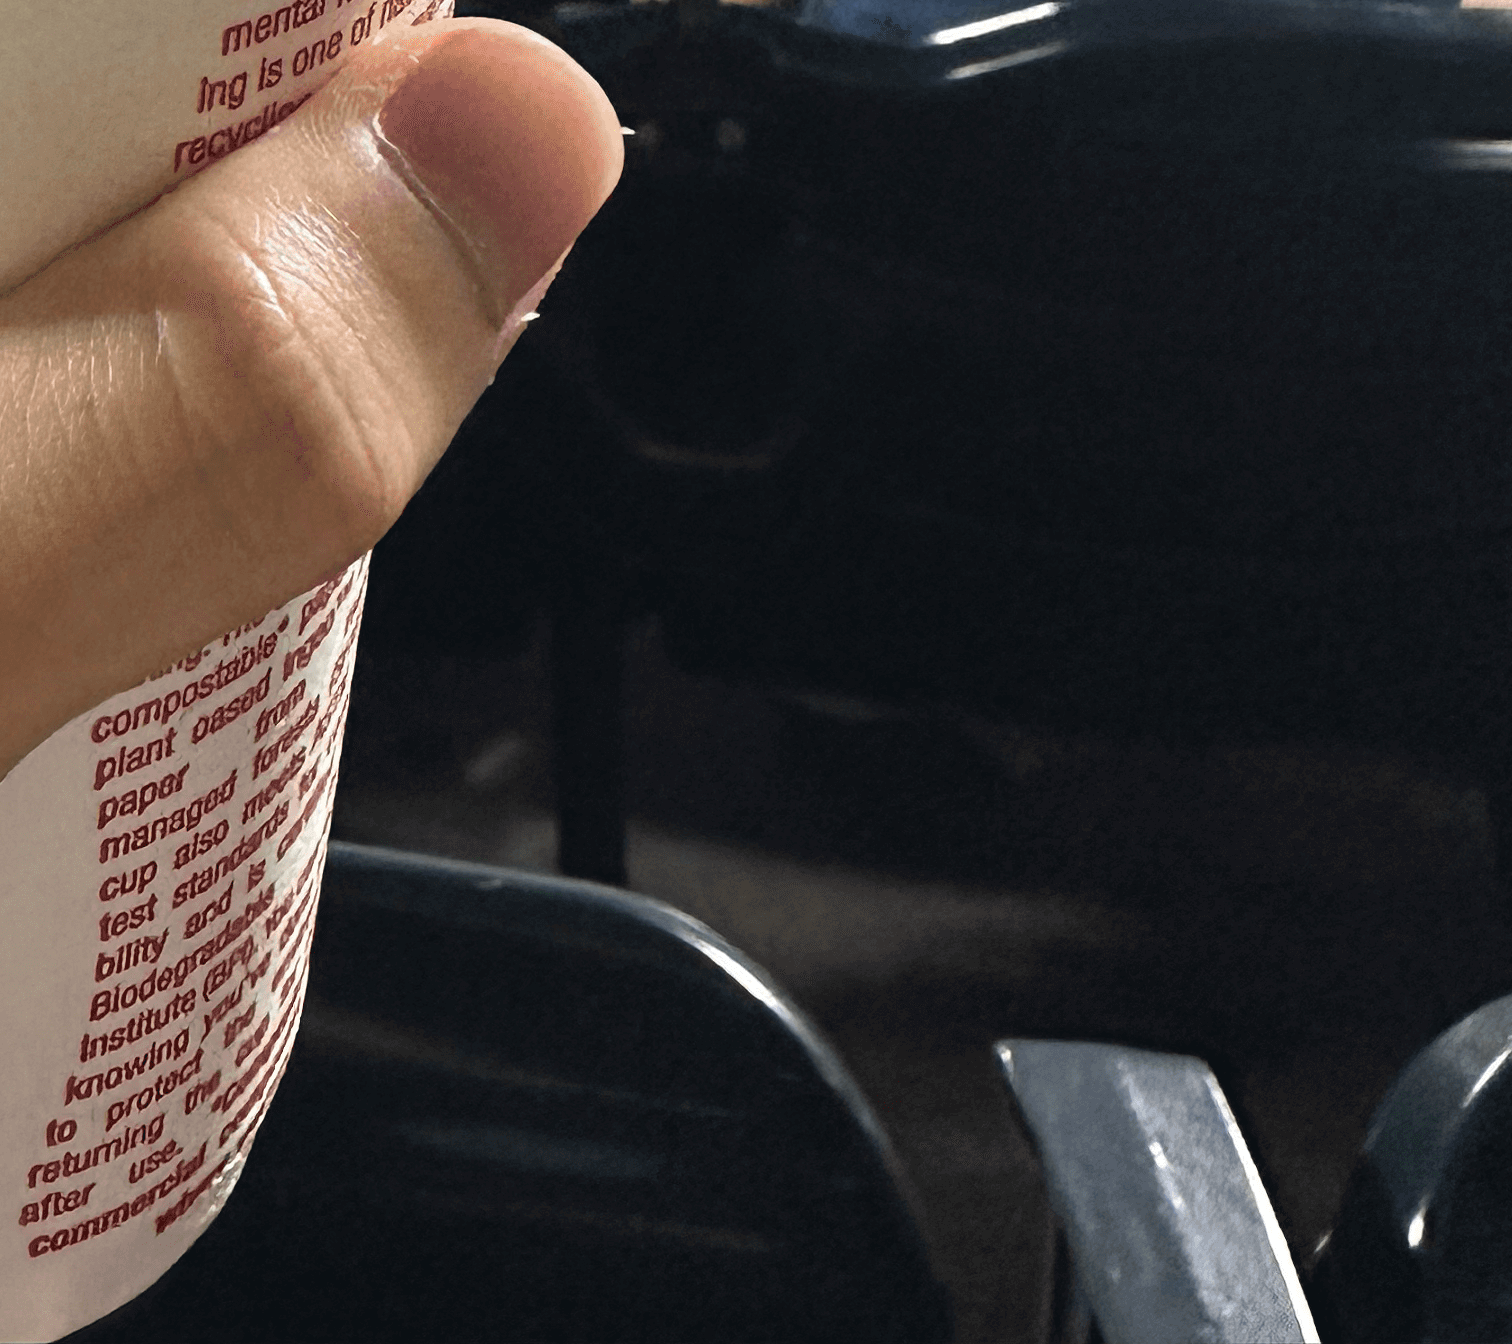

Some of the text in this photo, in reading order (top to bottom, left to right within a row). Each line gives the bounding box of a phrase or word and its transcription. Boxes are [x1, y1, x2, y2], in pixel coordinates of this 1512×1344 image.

[196, 74, 248, 114] ing
[256, 56, 283, 93] is
[291, 29, 344, 78] one
[91, 631, 279, 744] compostable
[93, 727, 179, 791] plant
[96, 763, 190, 830] paper
[98, 861, 158, 903] cup
[172, 818, 230, 871] also
[98, 894, 158, 942] test
[64, 1027, 190, 1107] knowing
[45, 1117, 79, 1148] to
[18, 1182, 96, 1227] after
